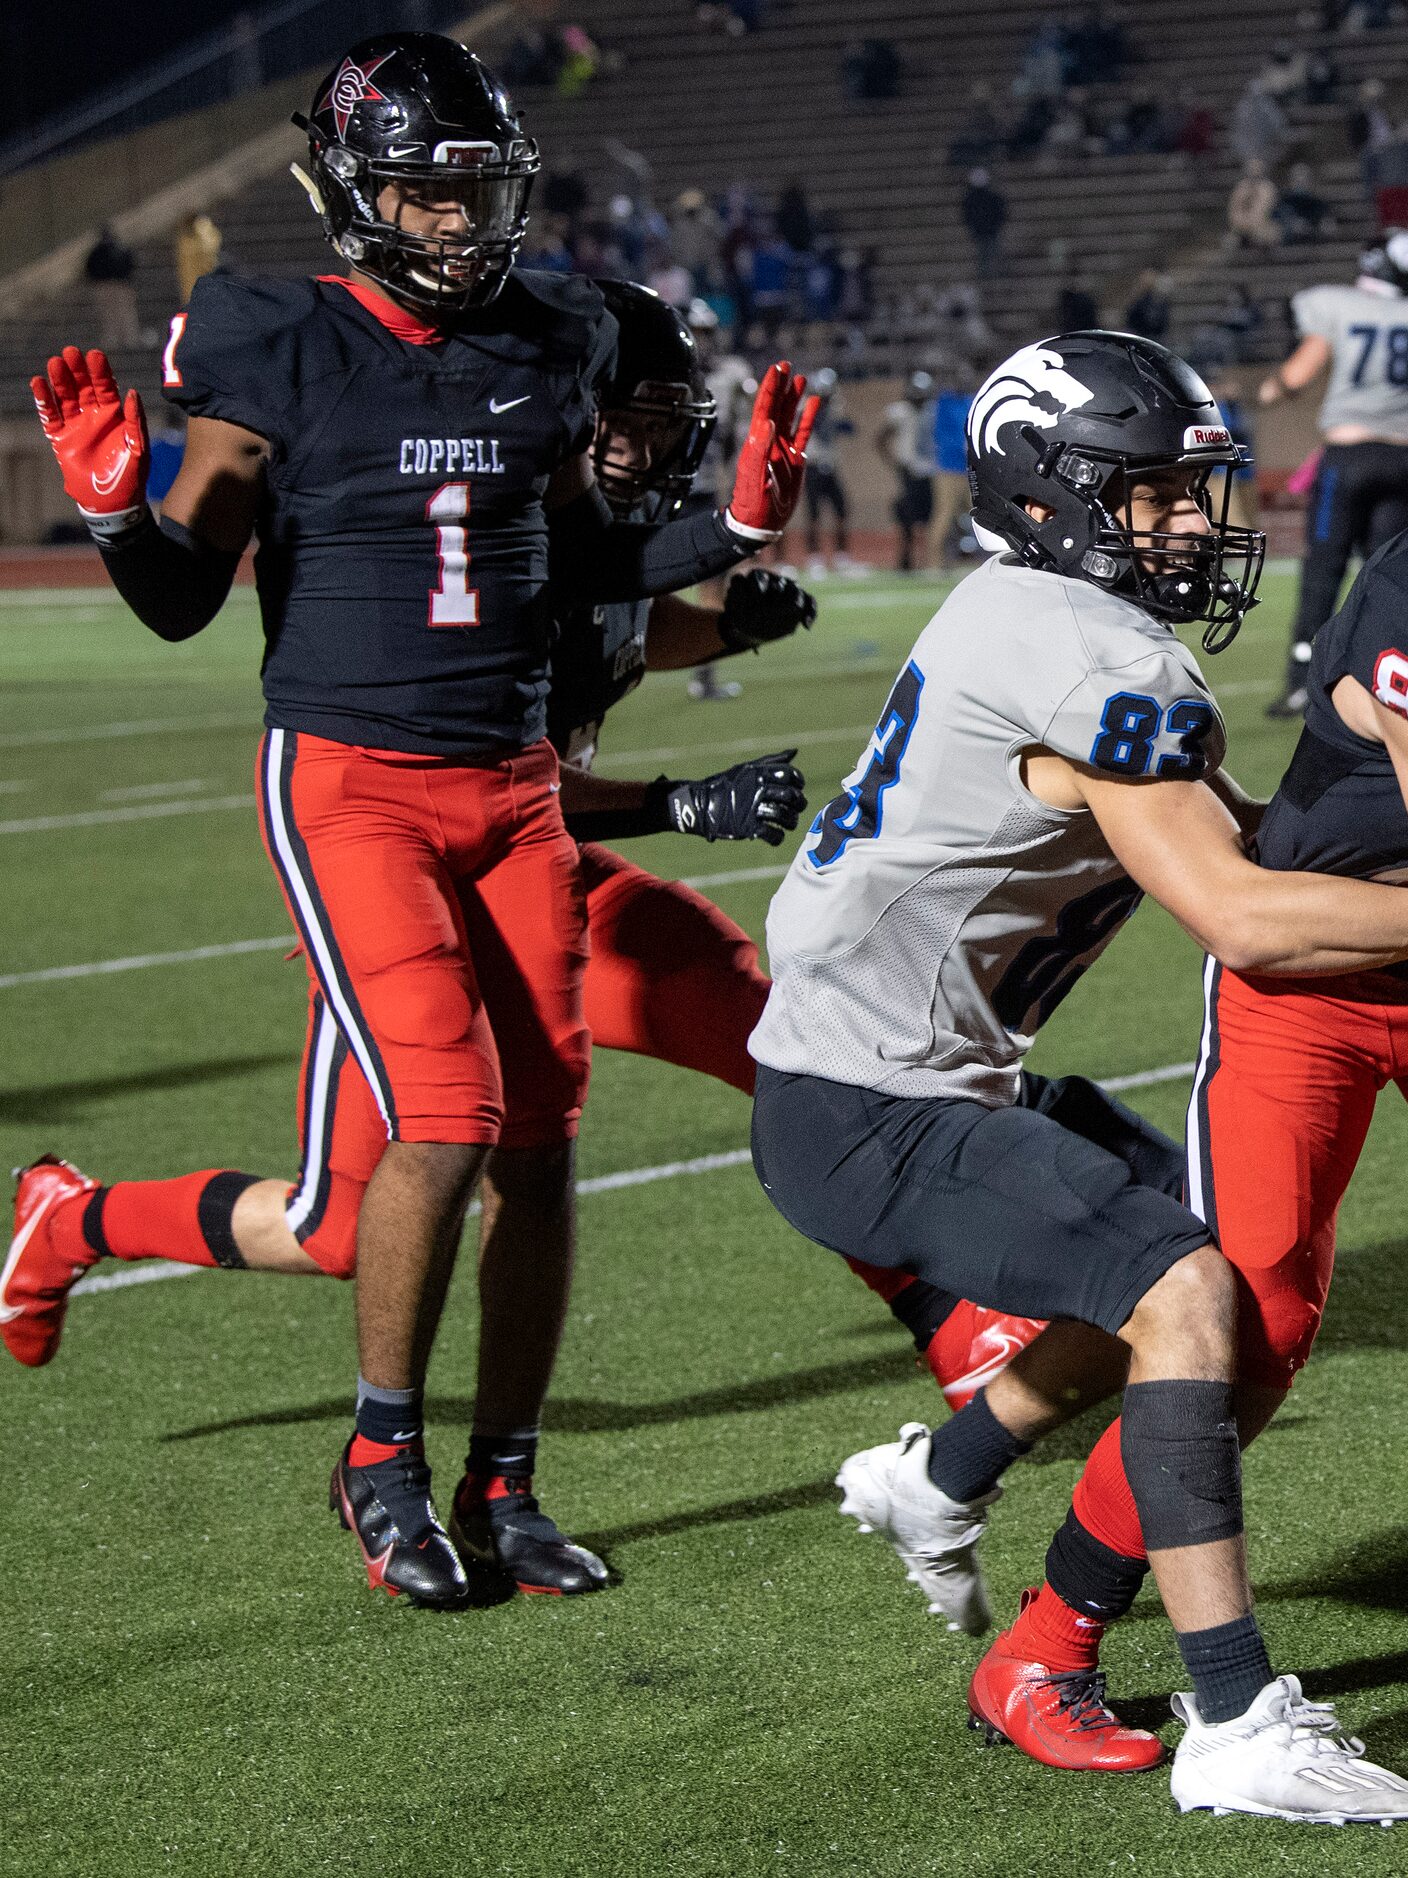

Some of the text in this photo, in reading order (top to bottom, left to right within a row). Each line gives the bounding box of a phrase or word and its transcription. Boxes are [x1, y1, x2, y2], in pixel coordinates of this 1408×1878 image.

[162, 313, 189, 387] 1
[400, 438, 506, 475] COPPELL
[424, 481, 481, 628] 1
[1088, 690, 1215, 778] 83
